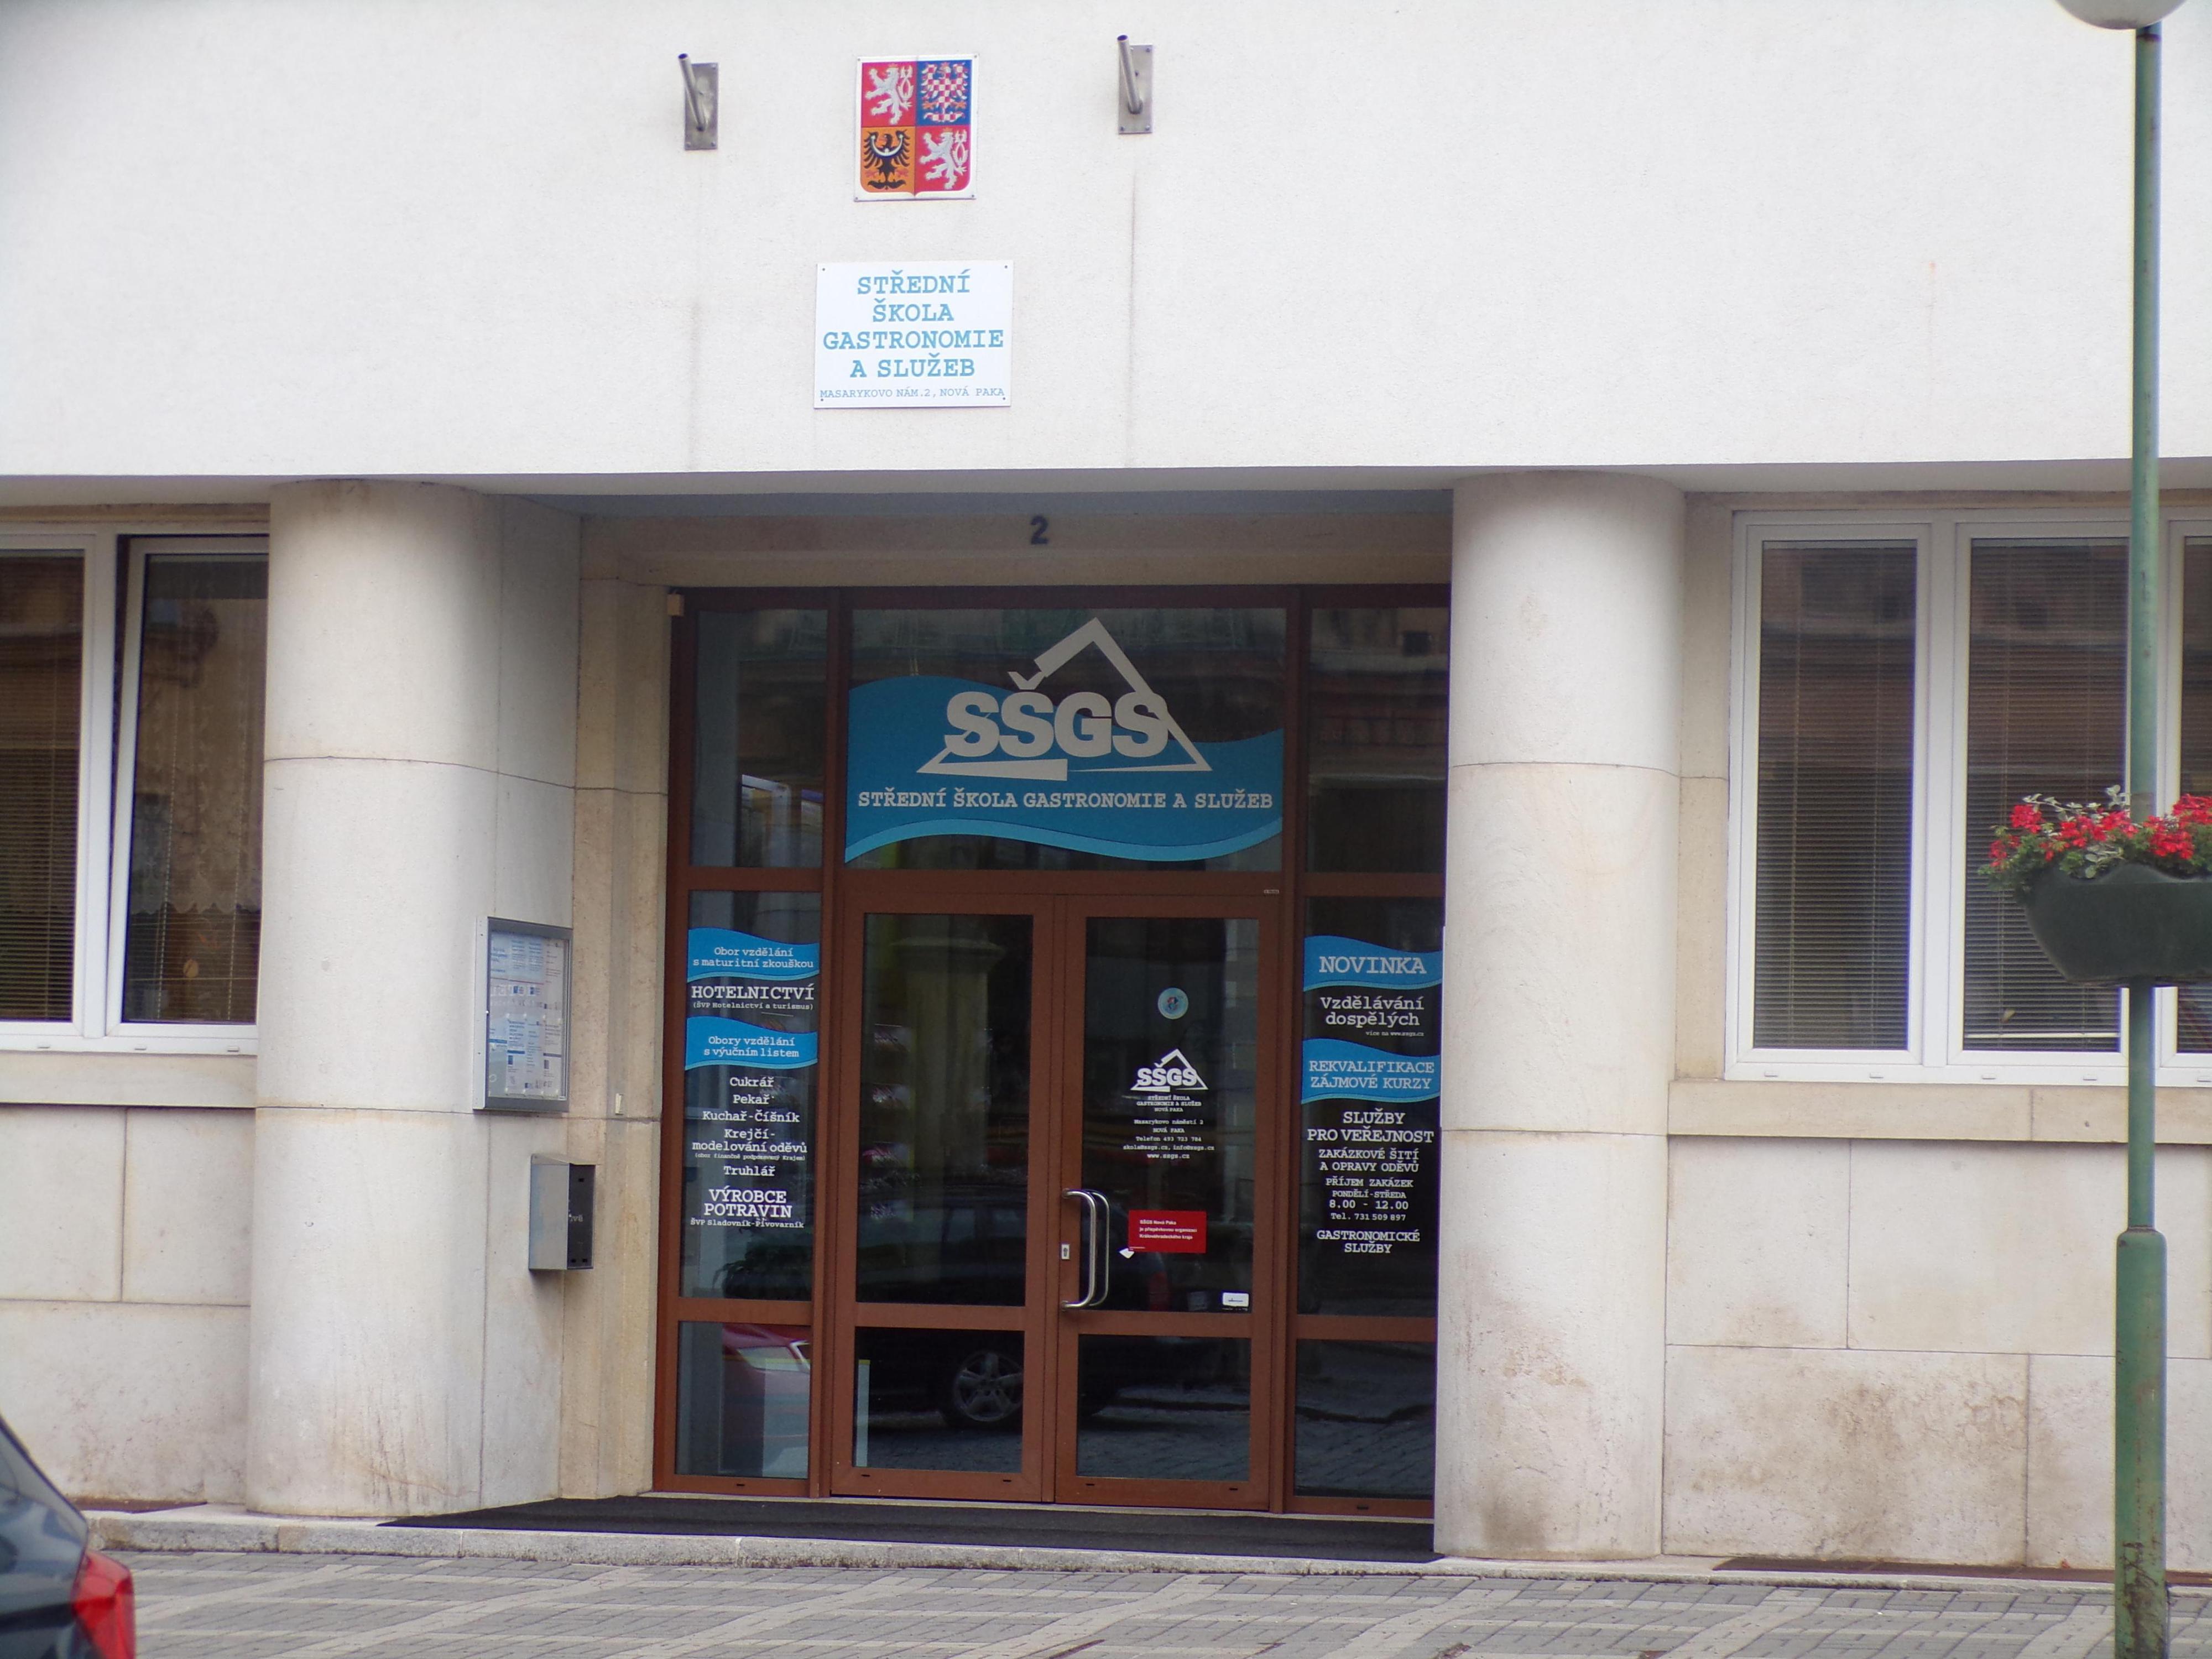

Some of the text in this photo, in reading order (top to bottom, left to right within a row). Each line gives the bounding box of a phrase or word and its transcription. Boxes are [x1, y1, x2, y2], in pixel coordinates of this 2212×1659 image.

[857, 268, 971, 294] STŘEDNÍ
[873, 298, 954, 322] ŠKOLA
[823, 330, 1004, 349] GASTRONOMIE
[850, 352, 975, 378] A SLUŽEB
[820, 389, 893, 398] MASARYKOVO
[940, 386, 969, 397] NOVÁ
[976, 388, 1005, 397] PAKA
[1030, 515, 1049, 545] 2
[944, 671, 1168, 758] SŠGS
[858, 786, 1273, 809] STŘEDNÍ ŠKOLA GASTRONOMIE A SLUŽEB
[714, 947, 794, 957] Obor vzdělání
[701, 958, 760, 968] maturitní
[763, 959, 813, 968] zkouškou
[1319, 956, 1427, 974] NOVINKA
[691, 983, 815, 1000] HOTELNICTVÍ
[1320, 996, 1425, 1010] Vzdělávání
[1326, 1012, 1420, 1028] dospělých
[708, 1036, 795, 1046] Obory vzdělání
[713, 1047, 758, 1057] výučním
[760, 1048, 799, 1057] listem
[1137, 1062, 1198, 1086] SŠGS
[1309, 1061, 1434, 1073] REKVALIFIKACE
[729, 1077, 774, 1087] Cukrář
[1311, 1073, 1432, 1089] ZÁJMOVÉ KURZY
[733, 1094, 770, 1104] Pekař
[1343, 1108, 1406, 1124] SLUŽBY
[1307, 1125, 1434, 1143] PRO VEŘEJNOST
[692, 1141, 807, 1153] modelování oděvů
[1319, 1147, 1420, 1160] ZAKÁZKOVÉ ŠITÍ
[724, 1166, 776, 1177] Truhlář
[1319, 1160, 1420, 1172] A OPRAVY ODĚVŮ
[1326, 1176, 1414, 1187] PŘÍJEM ZAKÁZEK
[708, 1186, 787, 1203] VÝROBCE
[704, 1203, 792, 1217] POTRAVIN
[1329, 1200, 1356, 1208] 8.00
[1375, 1201, 1408, 1210] 12.00
[1317, 1229, 1420, 1242] GASTRONOMICKÉ
[1344, 1240, 1392, 1254] SLUŽBY
